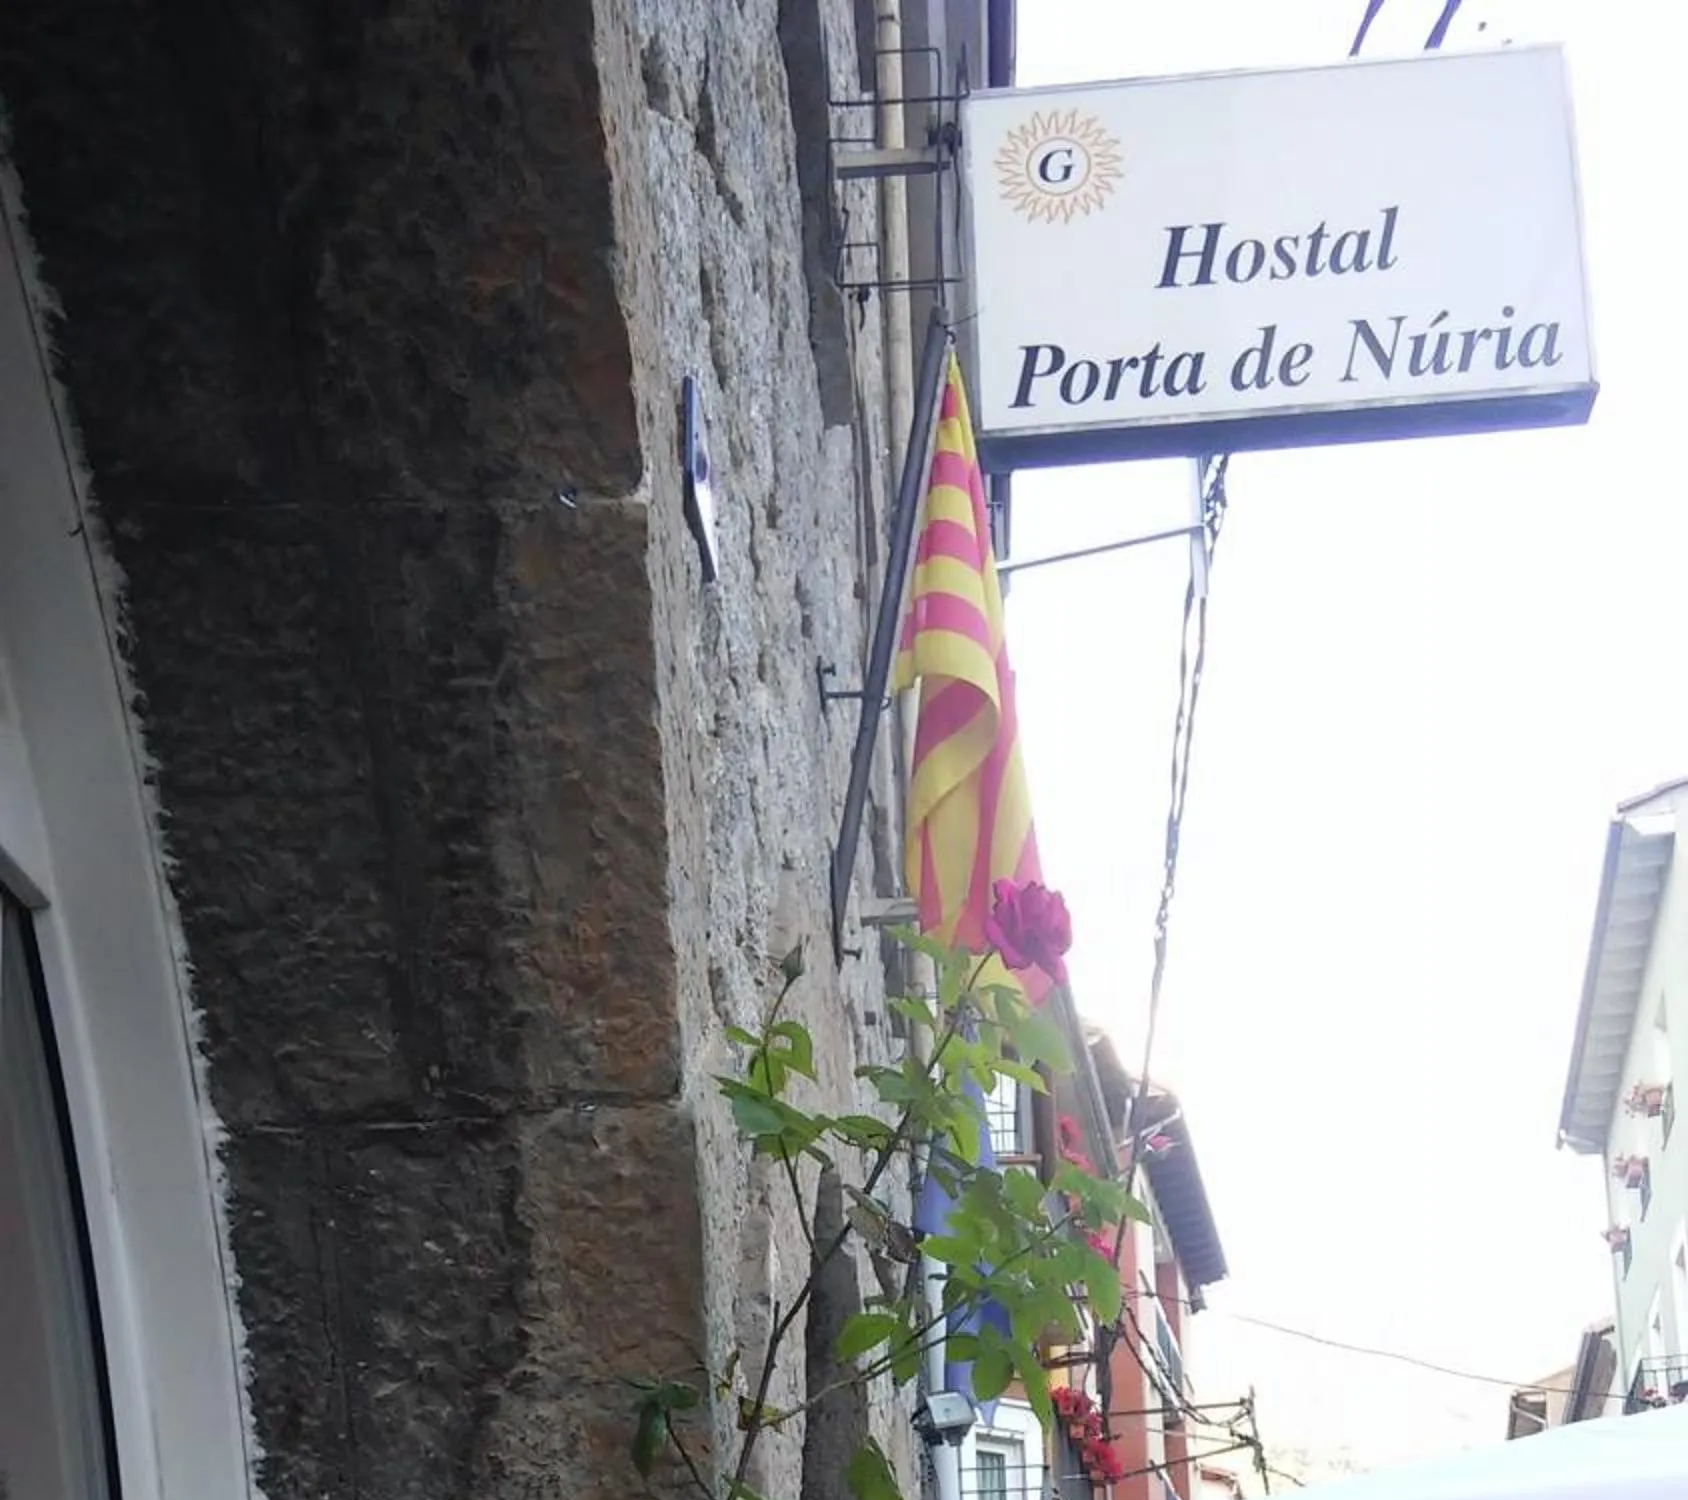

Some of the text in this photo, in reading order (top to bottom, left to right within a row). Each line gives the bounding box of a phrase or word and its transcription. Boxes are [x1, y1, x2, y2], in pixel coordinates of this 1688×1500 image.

[1037, 148, 1074, 184] G
[1153, 206, 1398, 289] Hostal
[1007, 306, 1564, 409] Porta de Núria
